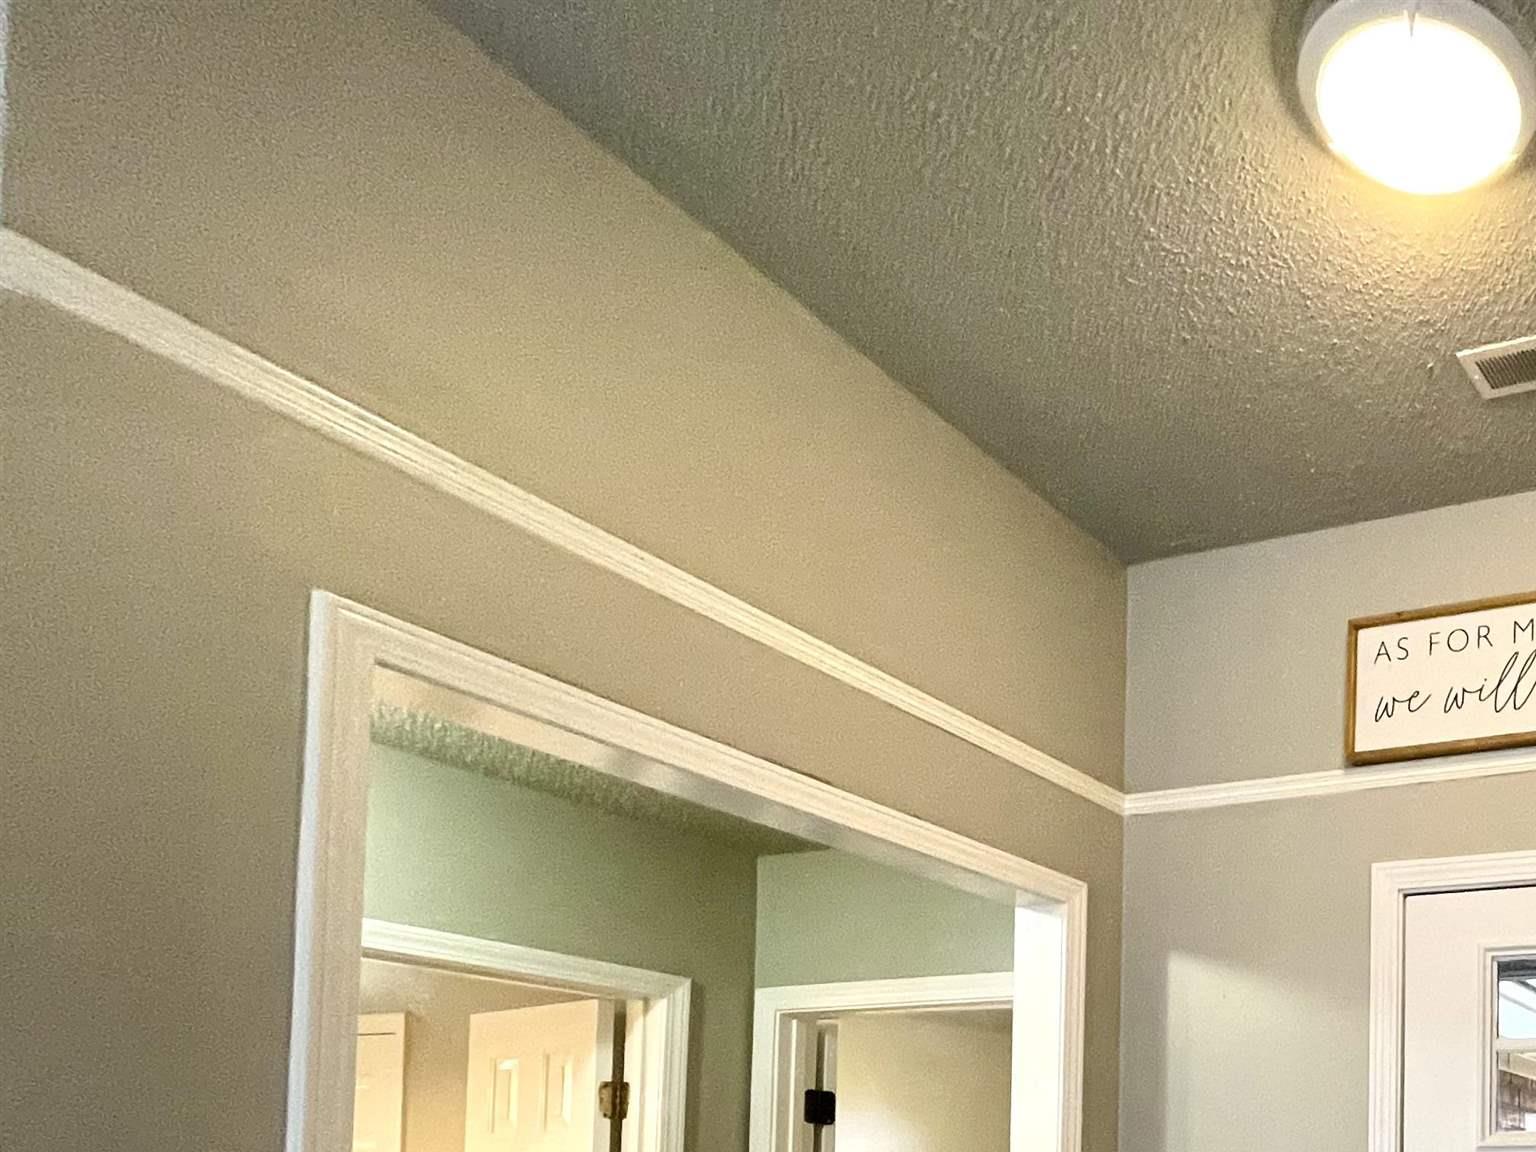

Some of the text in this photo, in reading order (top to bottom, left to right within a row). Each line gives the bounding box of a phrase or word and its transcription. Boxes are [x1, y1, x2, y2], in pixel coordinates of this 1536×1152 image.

[1373, 636, 1410, 665] AS
[1428, 624, 1494, 657] FOR
[1374, 688, 1432, 723] we
